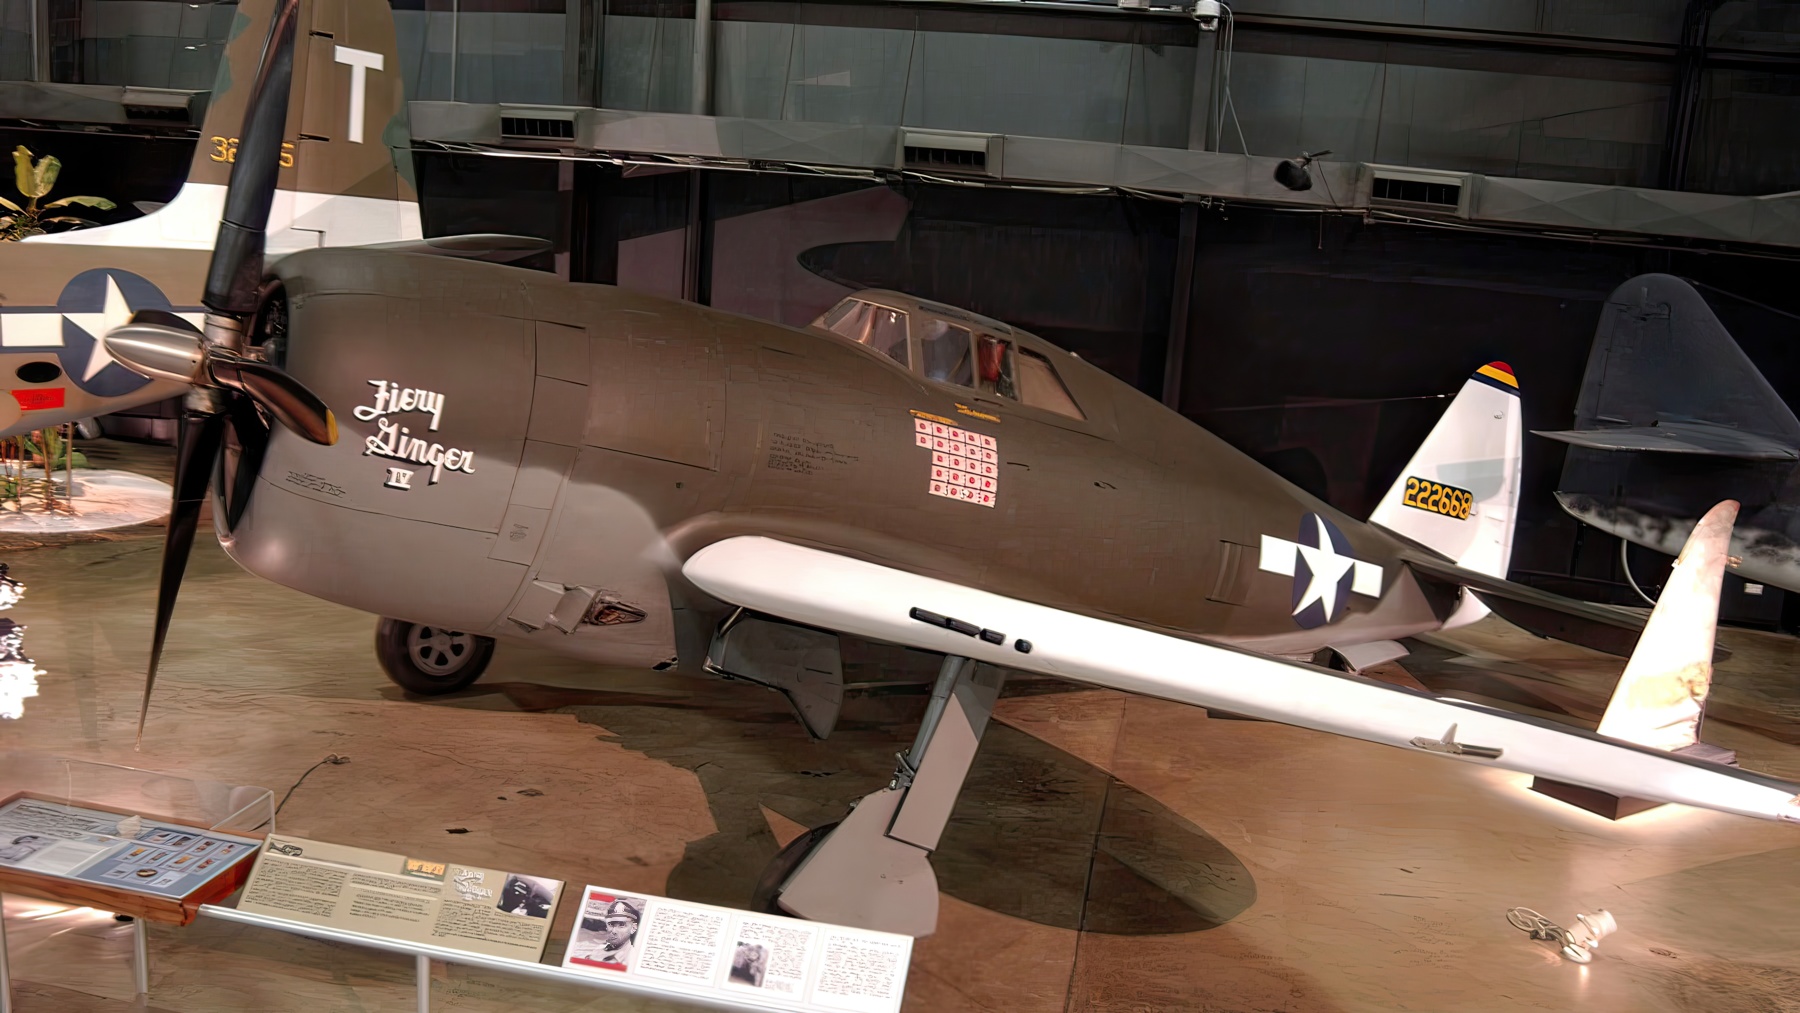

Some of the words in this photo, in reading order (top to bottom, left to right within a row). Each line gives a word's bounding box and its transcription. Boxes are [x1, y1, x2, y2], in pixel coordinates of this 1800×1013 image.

[334, 44, 385, 144] T
[353, 379, 446, 432] Fiery
[363, 417, 476, 486] Ginger
[384, 466, 414, 490] IV
[1403, 477, 1472, 520] 222668
